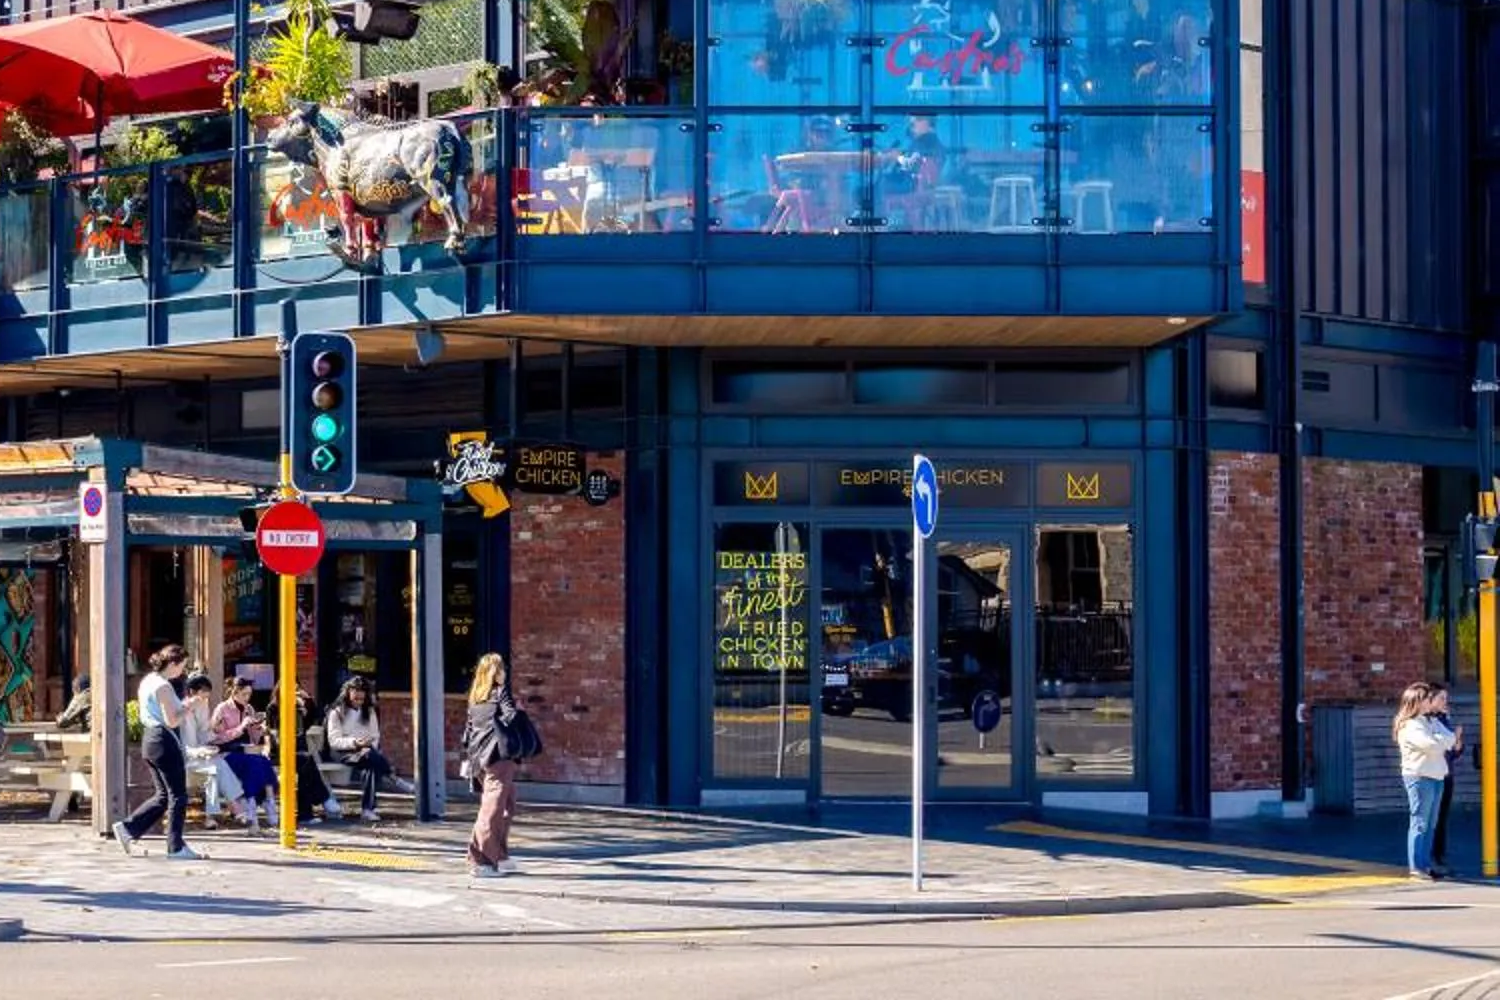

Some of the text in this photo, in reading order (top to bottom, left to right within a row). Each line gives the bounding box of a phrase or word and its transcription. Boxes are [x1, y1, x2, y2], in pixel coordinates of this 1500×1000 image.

[520, 450, 577, 467] EMPIRE
[515, 467, 581, 486] CHICKEN
[840, 469, 1003, 485] EMPIRE HICKEN
[285, 533, 311, 545] ENTRY
[720, 553, 805, 569] DEALERS
[747, 570, 791, 591] of the
[721, 577, 805, 628] finest
[739, 621, 804, 635] FRIED
[720, 637, 804, 653] CHICKEN
[721, 654, 804, 669] IN TOWN
